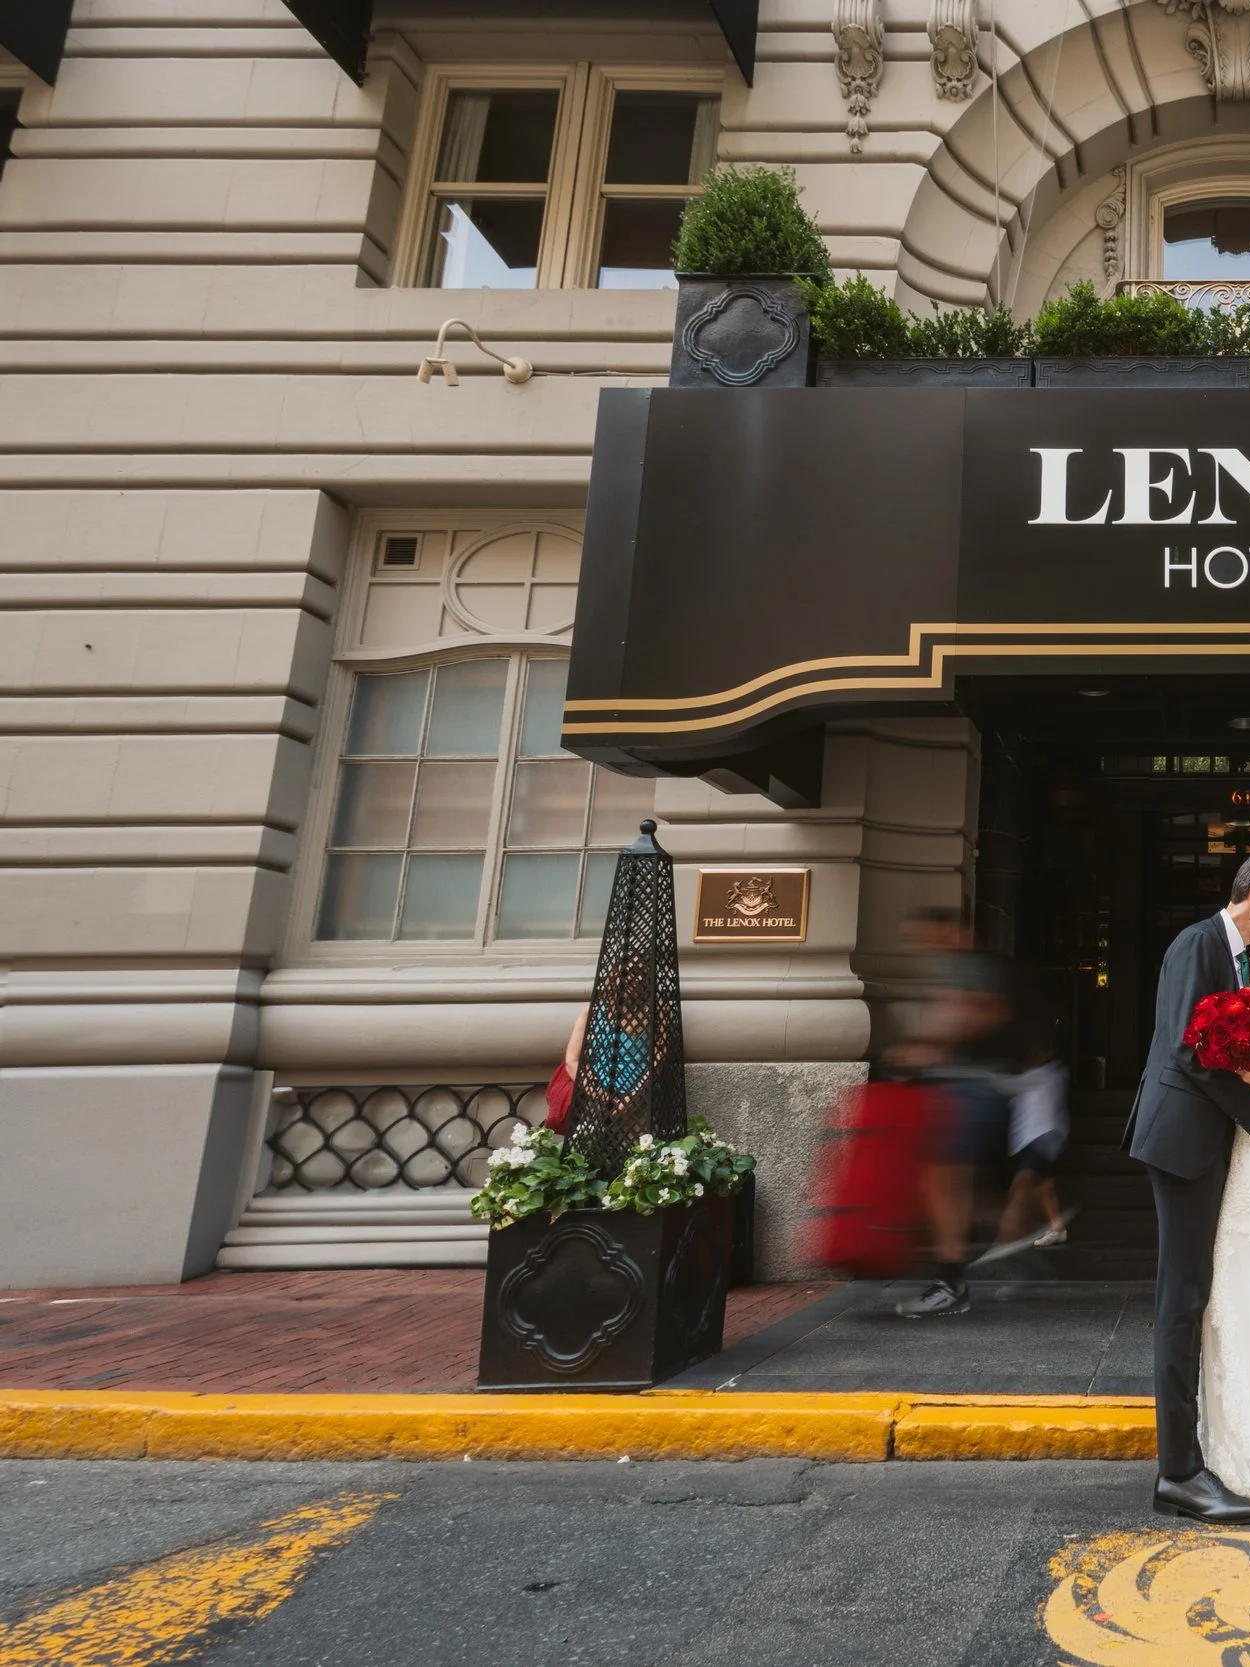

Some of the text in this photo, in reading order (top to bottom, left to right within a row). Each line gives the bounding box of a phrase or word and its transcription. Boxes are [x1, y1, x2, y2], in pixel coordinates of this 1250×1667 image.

[703, 918, 796, 927] THE LENOX HOTEL
